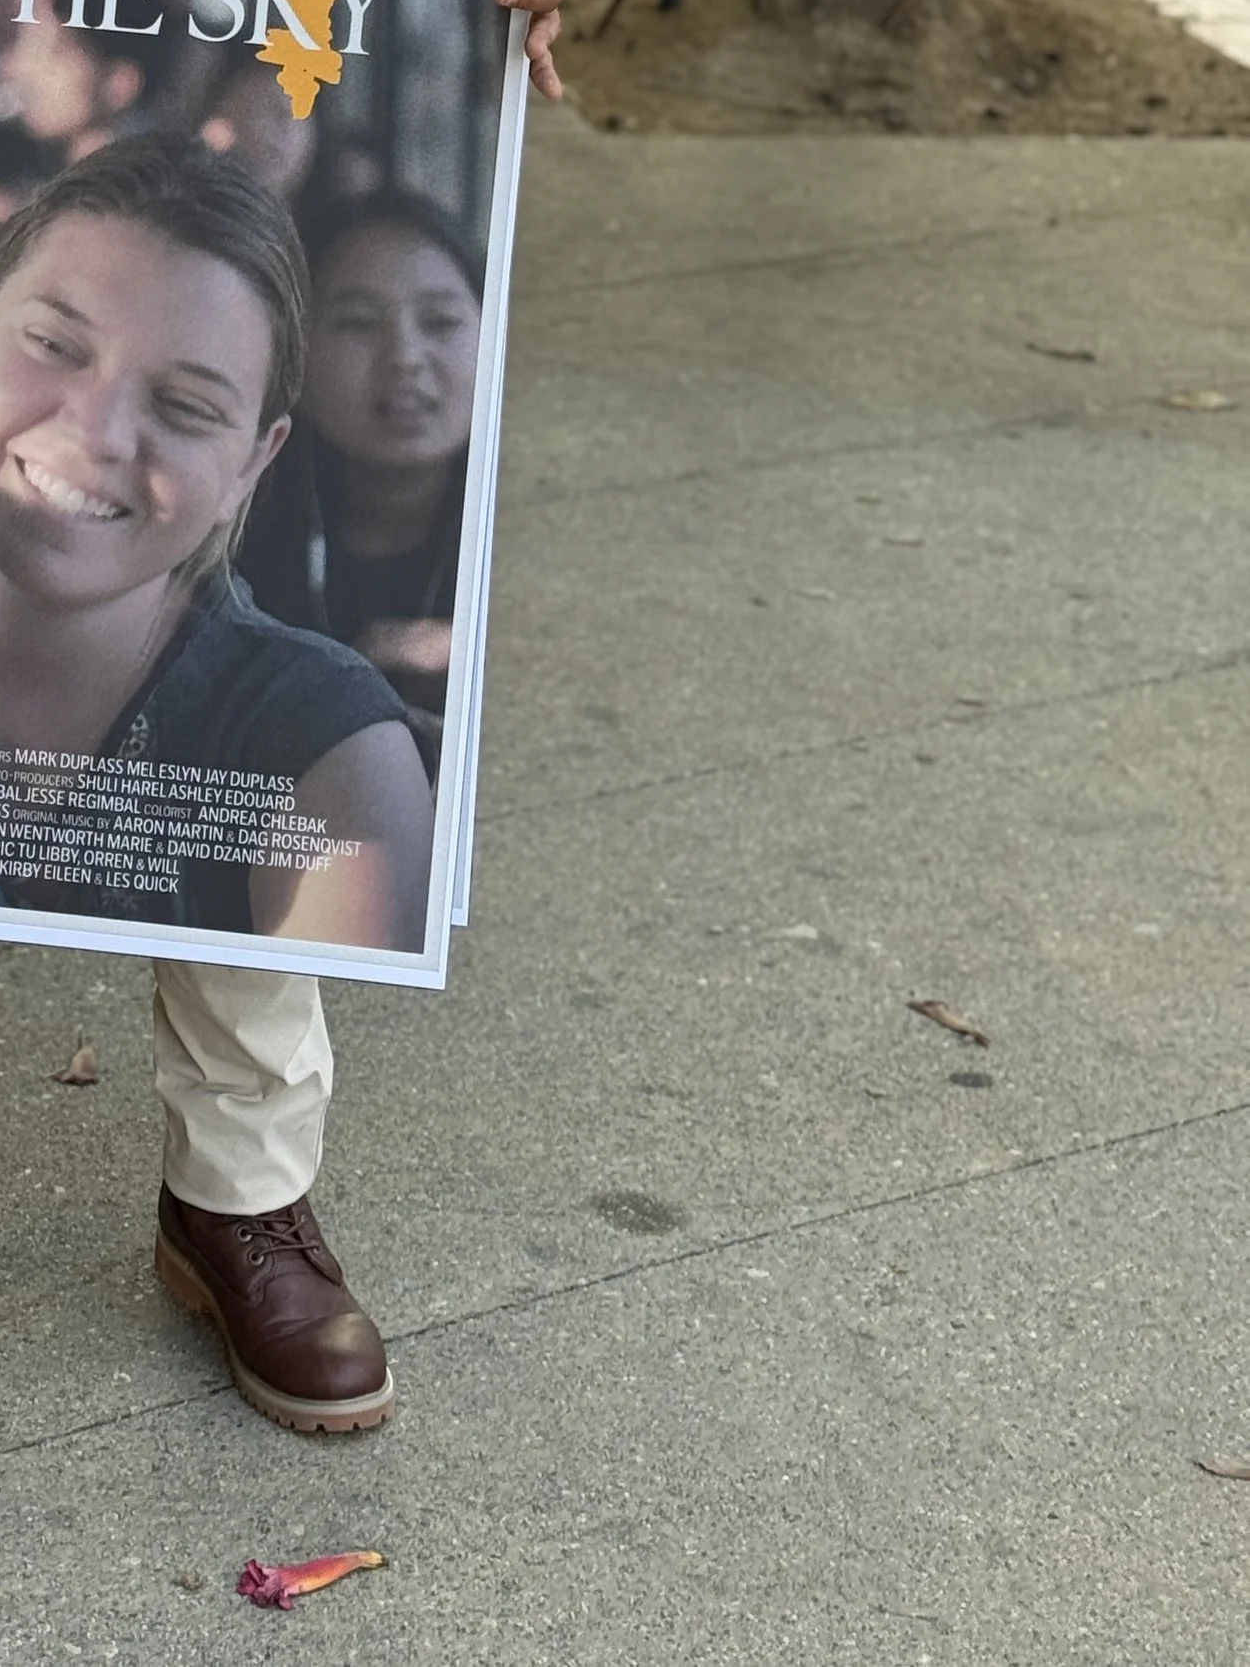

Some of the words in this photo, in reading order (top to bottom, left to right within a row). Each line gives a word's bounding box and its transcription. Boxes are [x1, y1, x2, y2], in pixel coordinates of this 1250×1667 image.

[14, 748, 57, 768] MARK
[60, 753, 123, 776] DUPLASS
[126, 760, 156, 779] MEL
[159, 764, 200, 784] ESLYN
[203, 768, 227, 786] JAY
[230, 772, 294, 793] DUPLASS
[77, 773, 118, 793] SHULI
[121, 777, 165, 798] HAREL
[168, 783, 221, 804] ASHLEY
[224, 789, 295, 812] EDOUARD
[12, 808, 58, 825] ORIGINAL
[61, 813, 93, 828] MUSIC
[96, 817, 110, 830] BY
[113, 814, 164, 836] AARON
[167, 821, 223, 842] MARTIN
[226, 830, 234, 844] &
[238, 829, 267, 848] DAG
[271, 833, 361, 858] ROSENQVIST
[23, 786, 65, 806] JESSE
[68, 791, 140, 815] REGIMBAL
[144, 803, 191, 820] COLORIST
[198, 806, 256, 828] ANDREA
[260, 812, 326, 835] CHLEBAK
[10, 823, 103, 849] WENTWORTH
[107, 833, 152, 854] MARIE
[155, 841, 164, 856] &
[167, 840, 209, 861] DAVID
[213, 845, 264, 866] DZANIS
[267, 851, 291, 869] JIM
[295, 853, 331, 874] DUFF
[17, 841, 35, 860] TU
[39, 844, 80, 866] LIBBY,
[83, 849, 132, 871] ORREN
[136, 857, 144, 872] &
[147, 856, 179, 876] WILL
[0, 858, 41, 880] KIRBY
[44, 863, 91, 885] EILEEN
[94, 872, 102, 887] &
[105, 870, 130, 889] LES
[133, 873, 178, 895] QUICK
